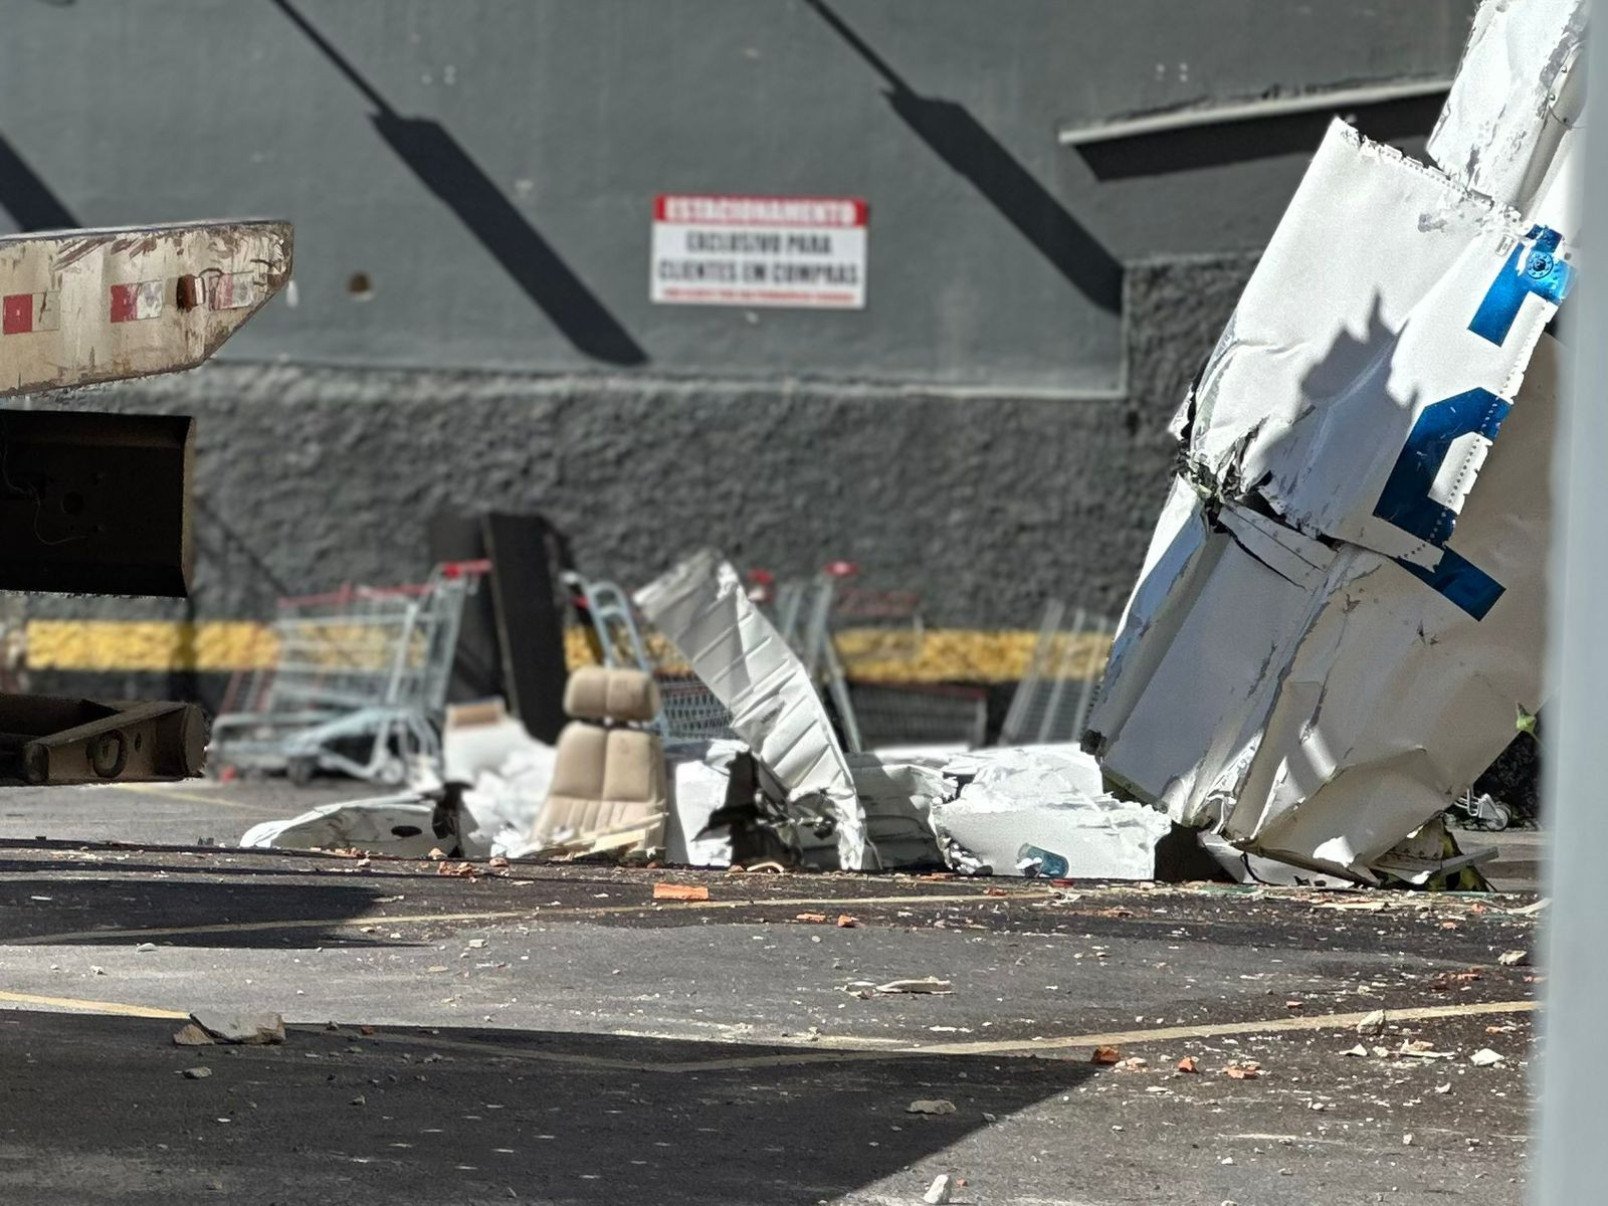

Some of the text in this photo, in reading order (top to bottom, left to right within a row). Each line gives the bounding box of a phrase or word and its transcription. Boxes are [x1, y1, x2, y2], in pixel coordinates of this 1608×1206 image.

[686, 231, 832, 254] EXCLUSIVO PARA
[658, 259, 858, 284] CLIENTES EM COMPRAS
